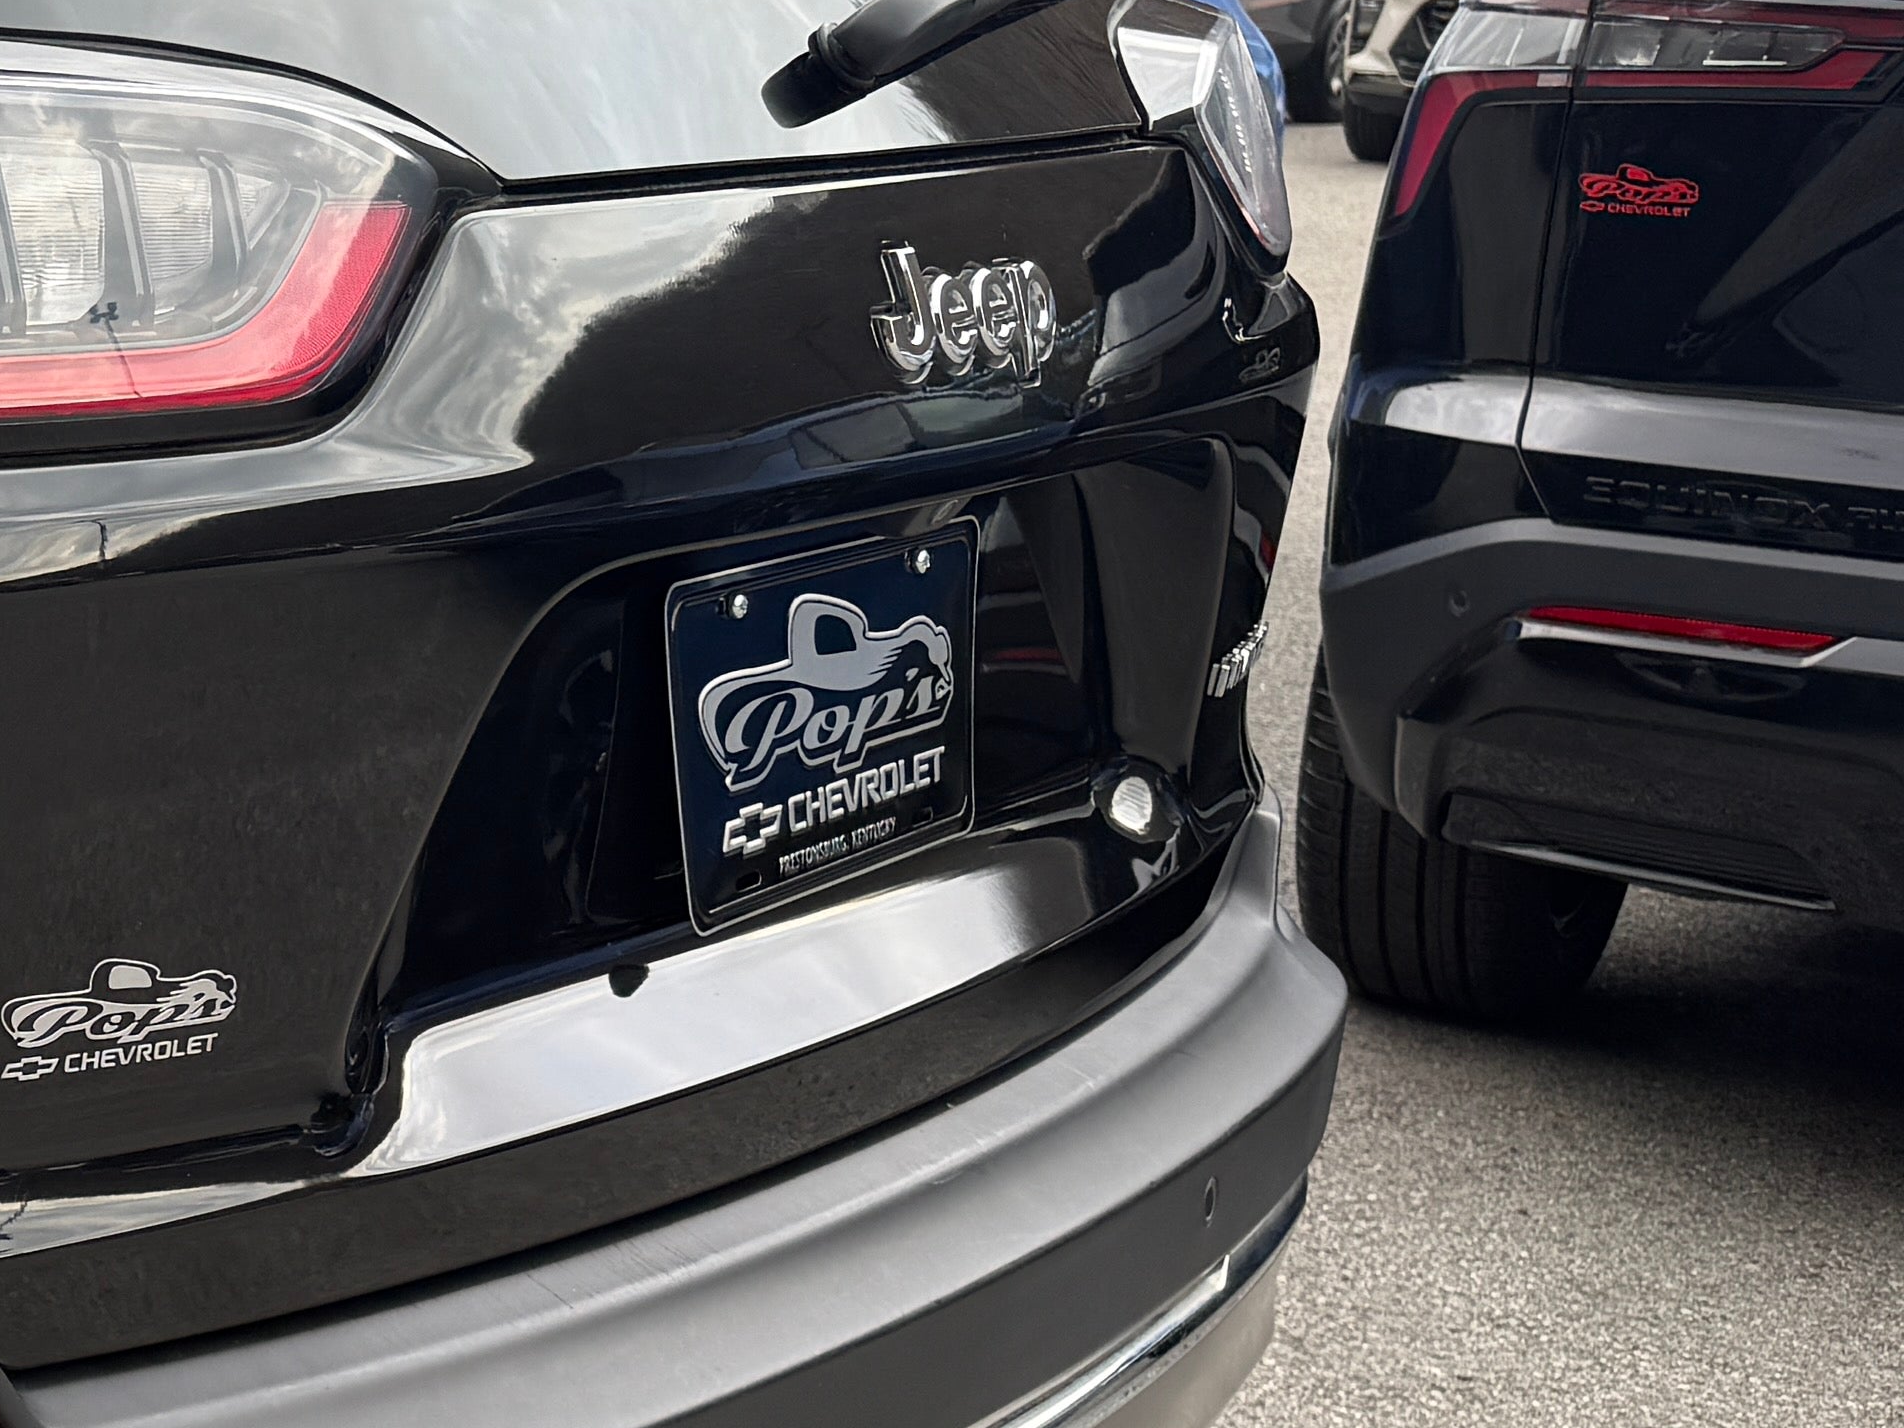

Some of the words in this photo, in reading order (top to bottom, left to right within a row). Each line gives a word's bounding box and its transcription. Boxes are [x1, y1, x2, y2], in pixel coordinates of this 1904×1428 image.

[1607, 202, 1691, 218] CHEVROLET
[870, 240, 1057, 389] Jeep
[724, 668, 942, 773] Pop's
[787, 746, 946, 833] CHEVROLET
[851, 816, 897, 853] KENTUCKY
[63, 1033, 219, 1073] CHEVROLET
